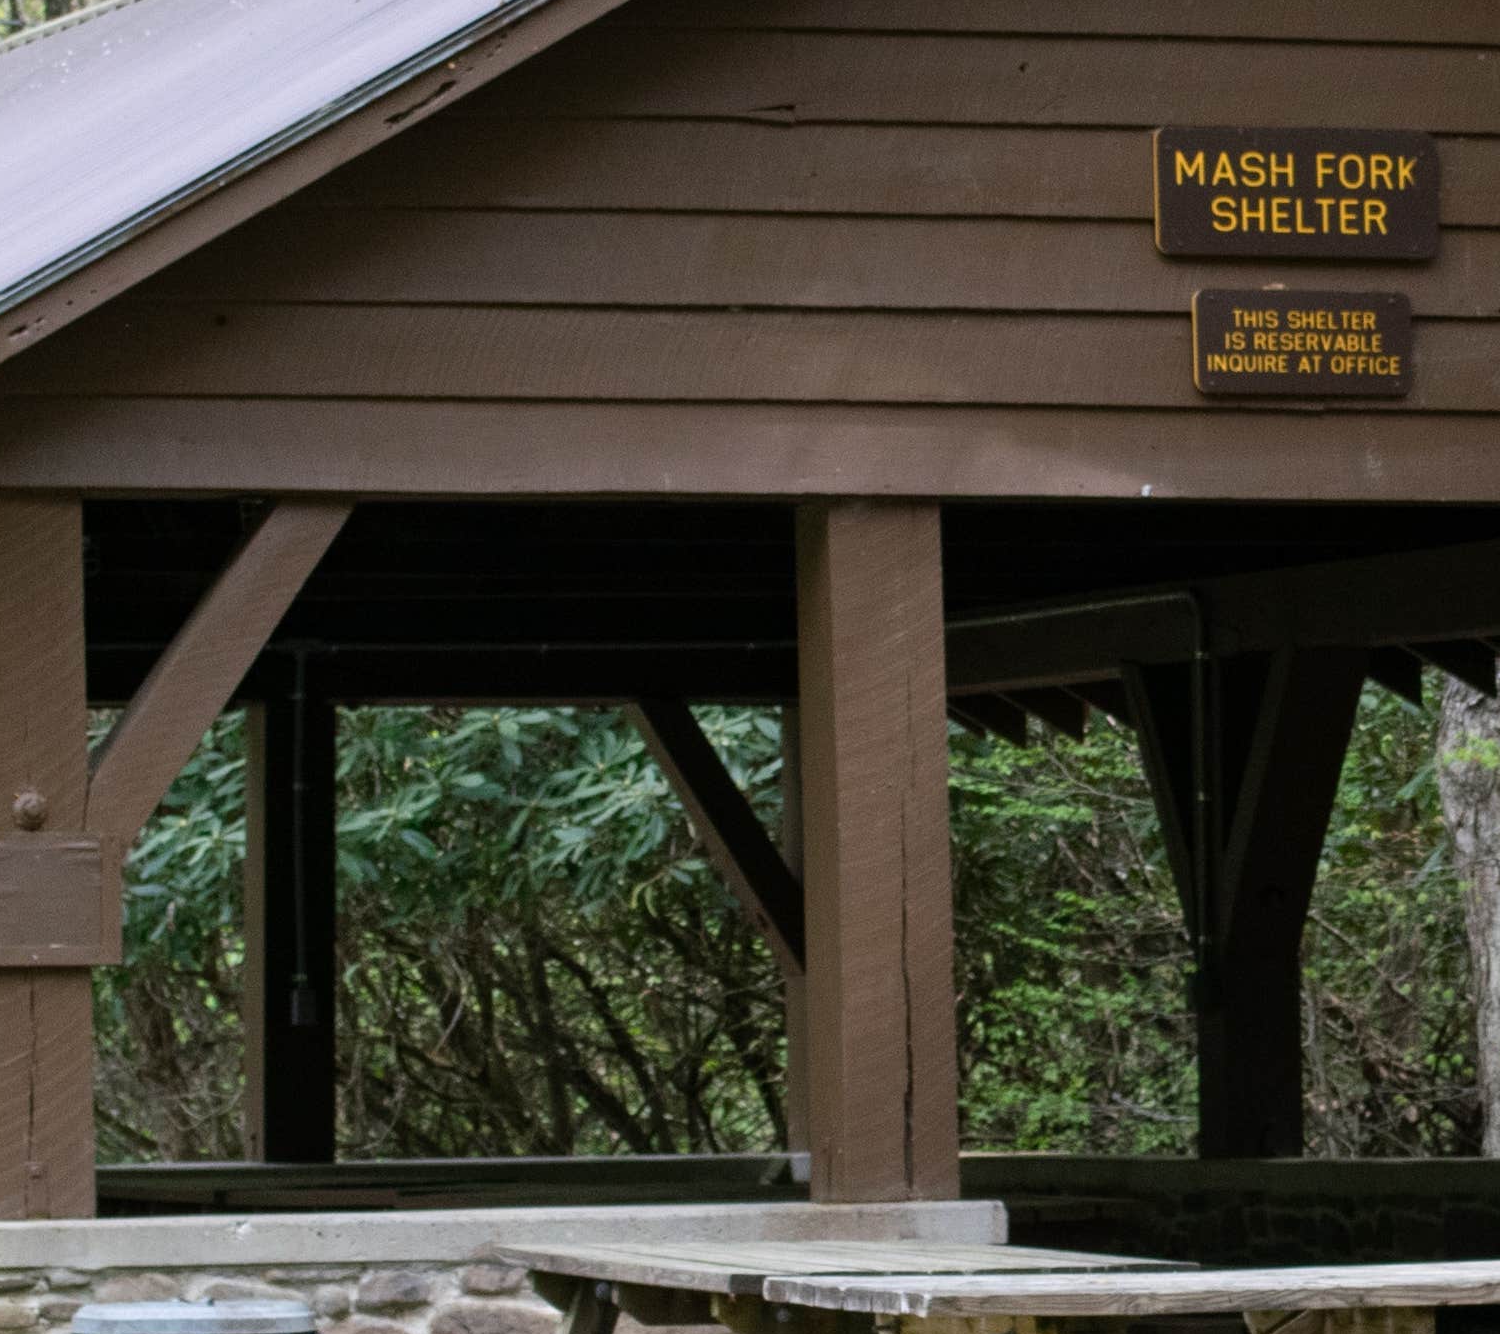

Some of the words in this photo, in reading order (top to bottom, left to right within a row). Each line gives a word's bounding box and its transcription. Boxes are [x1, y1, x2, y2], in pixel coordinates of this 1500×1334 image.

[1173, 150, 1295, 188] MASH
[1315, 152, 1417, 190] FORK
[1210, 196, 1388, 235] SHELTER
[1232, 308, 1280, 329] THIS
[1286, 309, 1377, 330] SHELTER
[1224, 331, 1247, 351] IS
[1253, 332, 1382, 354] RESERVABLE
[1206, 354, 1288, 374] INQUIRE
[1297, 355, 1322, 374] AT
[1329, 355, 1401, 376] OFFICE
